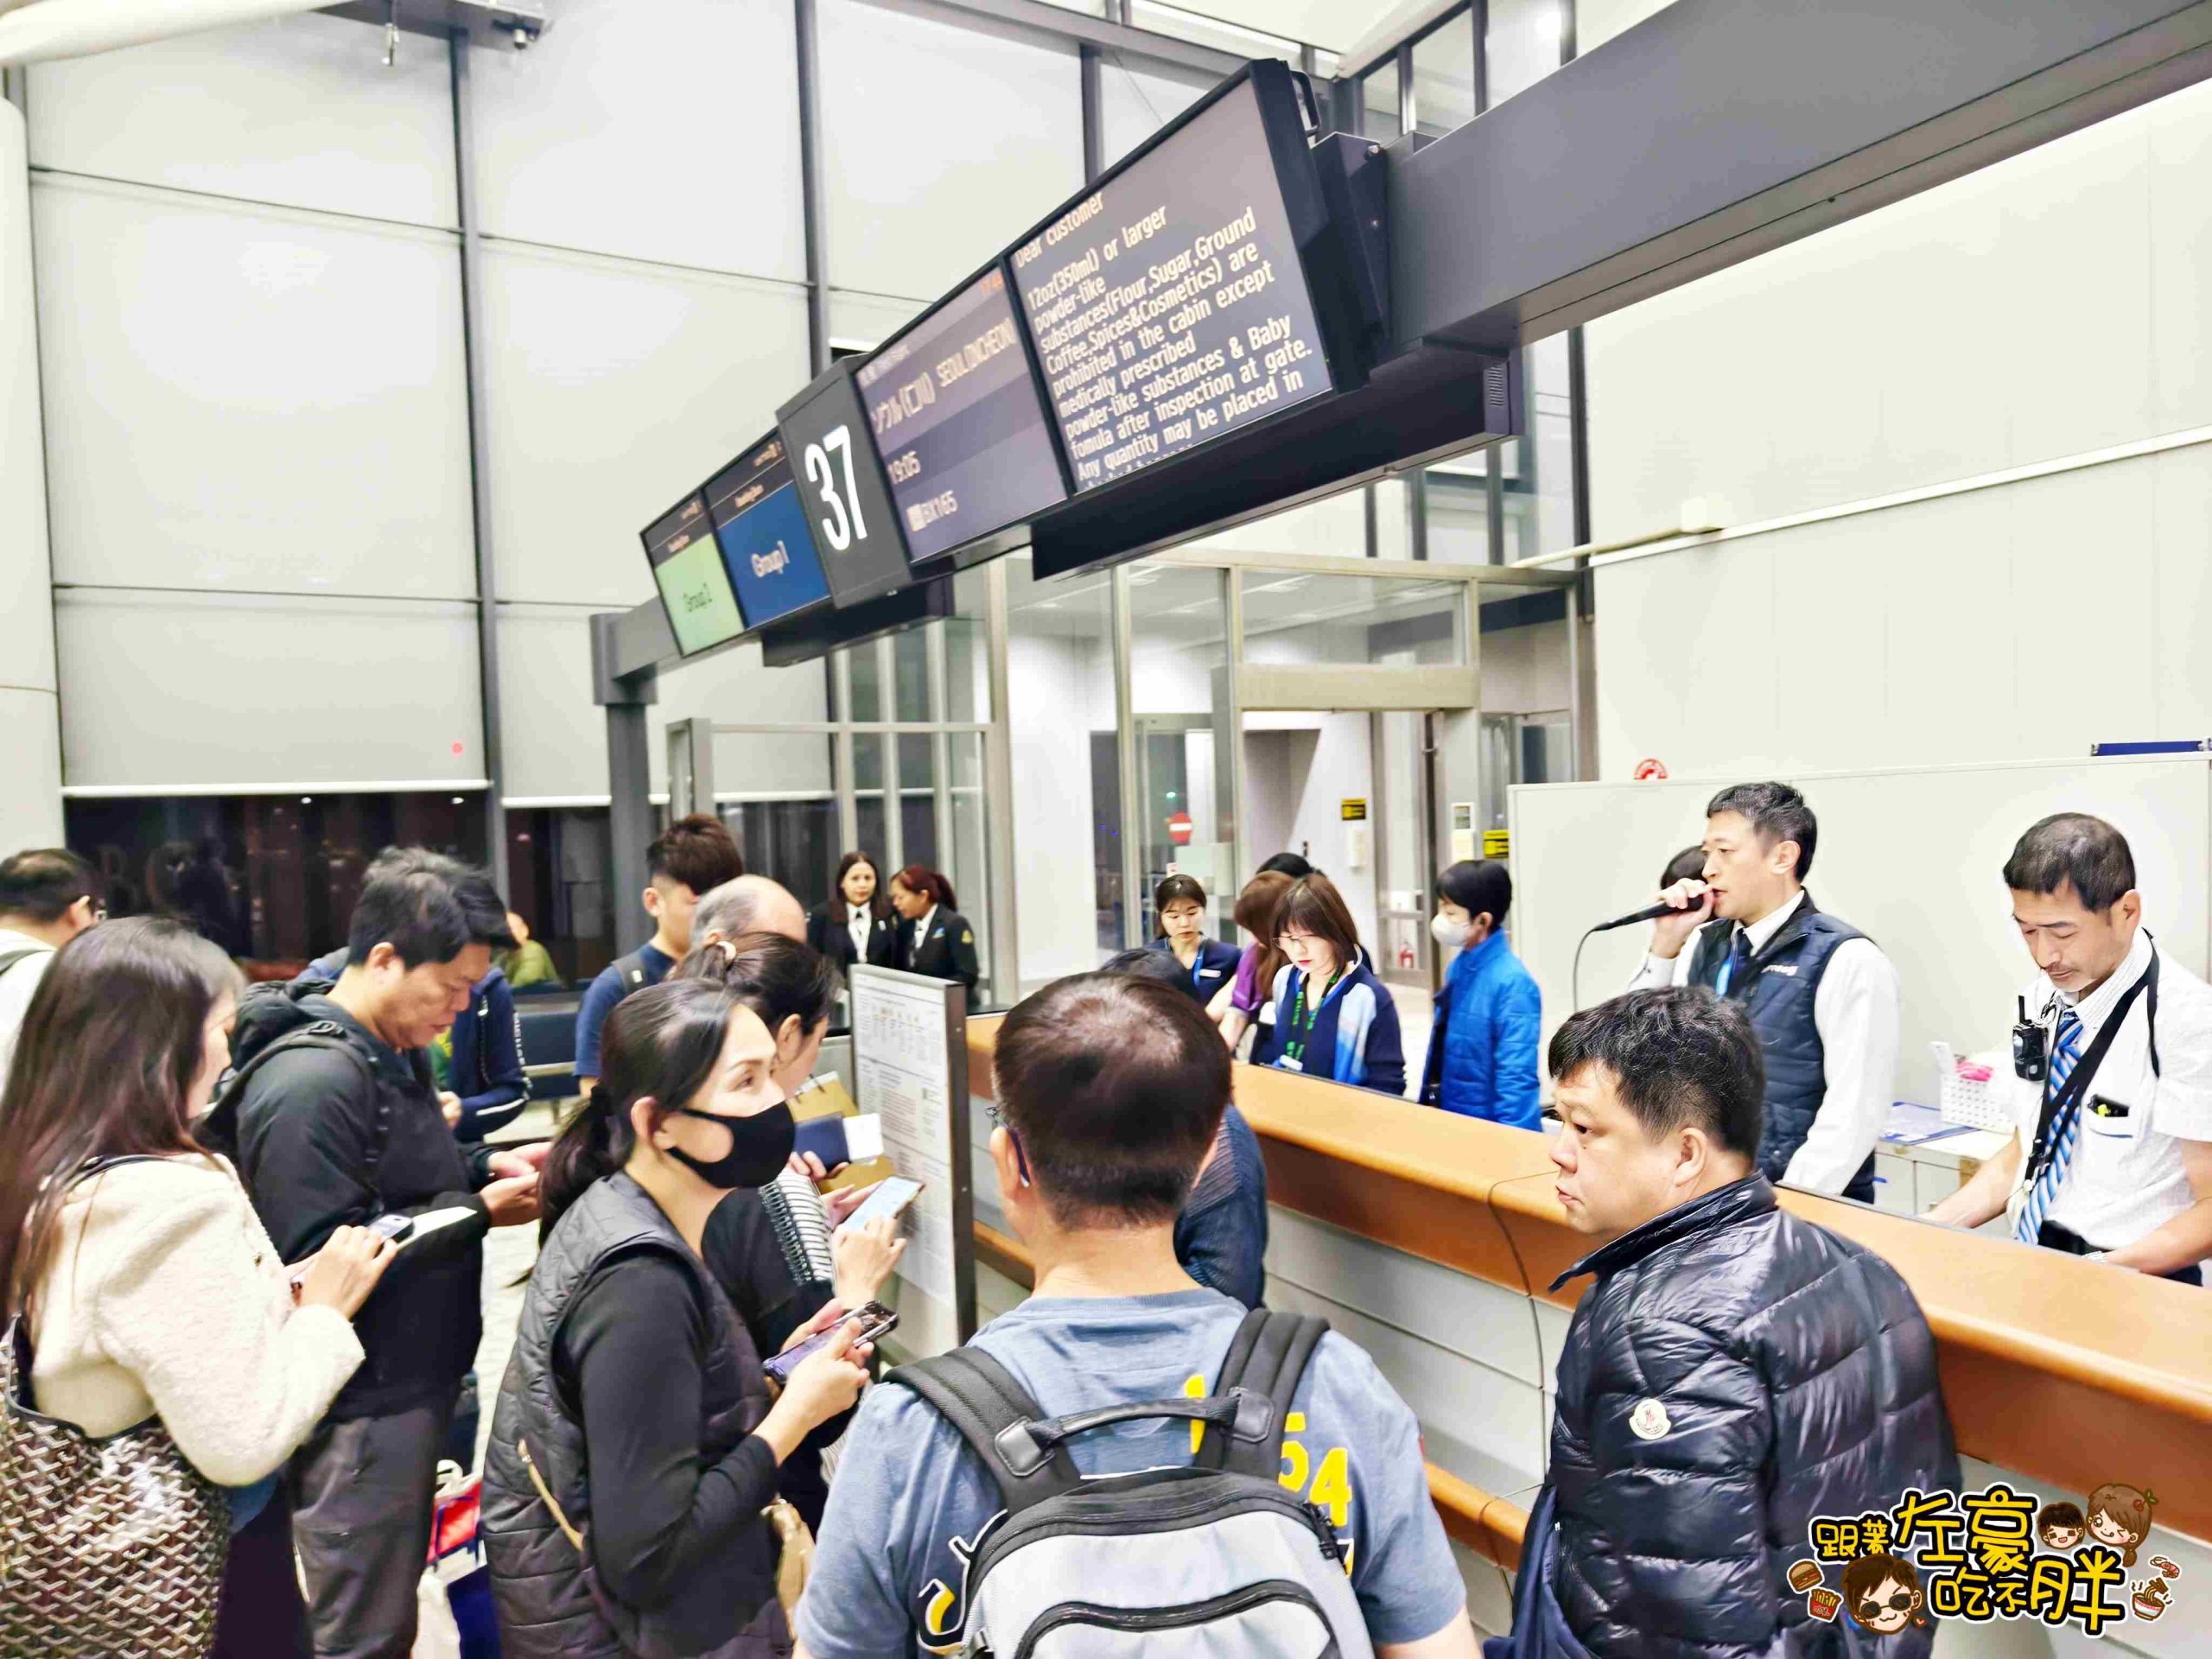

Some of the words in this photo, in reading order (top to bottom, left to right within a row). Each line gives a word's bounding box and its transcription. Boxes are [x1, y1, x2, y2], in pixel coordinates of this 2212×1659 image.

[1046, 192, 1104, 245] customer
[1103, 238, 1119, 261] or
[1122, 206, 1166, 248] larger
[1228, 242, 1260, 272] are
[1034, 276, 1107, 335] powder-like
[1052, 346, 1118, 400] prohibited
[1119, 340, 1136, 360] in
[1137, 325, 1166, 350] the
[1168, 298, 1212, 334] cabin
[1216, 260, 1275, 308] except
[1058, 376, 1116, 419] medically
[1120, 330, 1197, 389] prescribed
[1065, 391, 1140, 442] powder-like
[1141, 348, 1226, 403] substances
[1229, 336, 1244, 359] &
[1247, 315, 1292, 351] Baby
[1116, 410, 1151, 440] after
[1154, 372, 1236, 423] inspection
[1239, 357, 1261, 384] at
[1264, 339, 1313, 376] gate.
[888, 450, 921, 485] 19:05
[1077, 459, 1101, 481] Any
[1103, 433, 1159, 471] quantity
[1162, 417, 1192, 445] may
[1195, 407, 1218, 430] be
[1222, 375, 1279, 422] placed
[1281, 369, 1304, 393] in
[804, 424, 868, 551] 37
